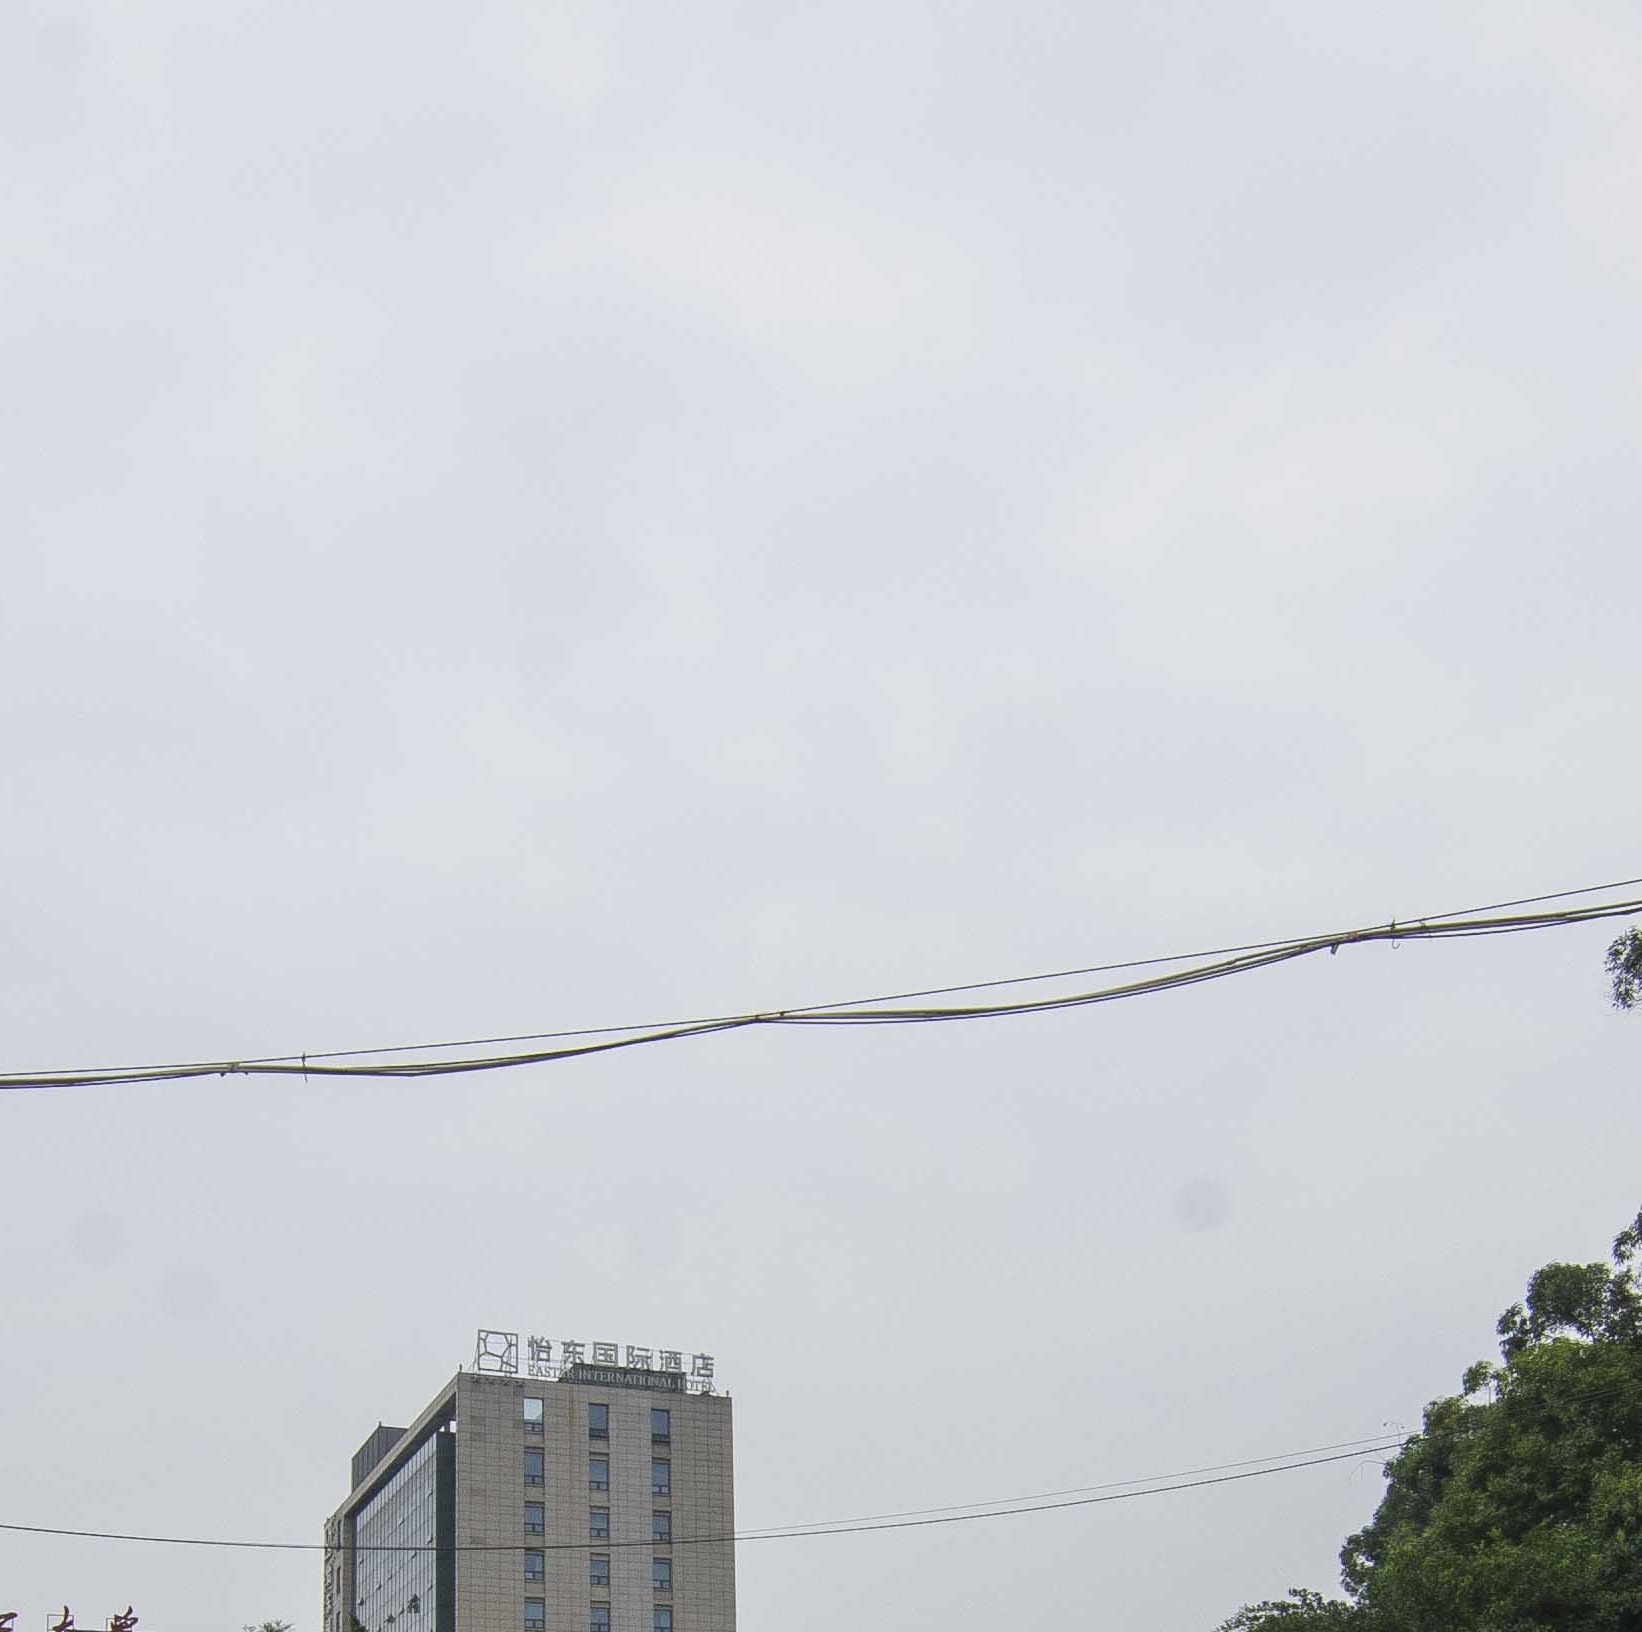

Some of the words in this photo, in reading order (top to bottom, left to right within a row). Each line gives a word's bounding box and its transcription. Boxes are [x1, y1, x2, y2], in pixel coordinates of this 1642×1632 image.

[527, 1335, 715, 1378] 怡东国际酒店
[578, 1370, 676, 1390] INTERNATIONAL
